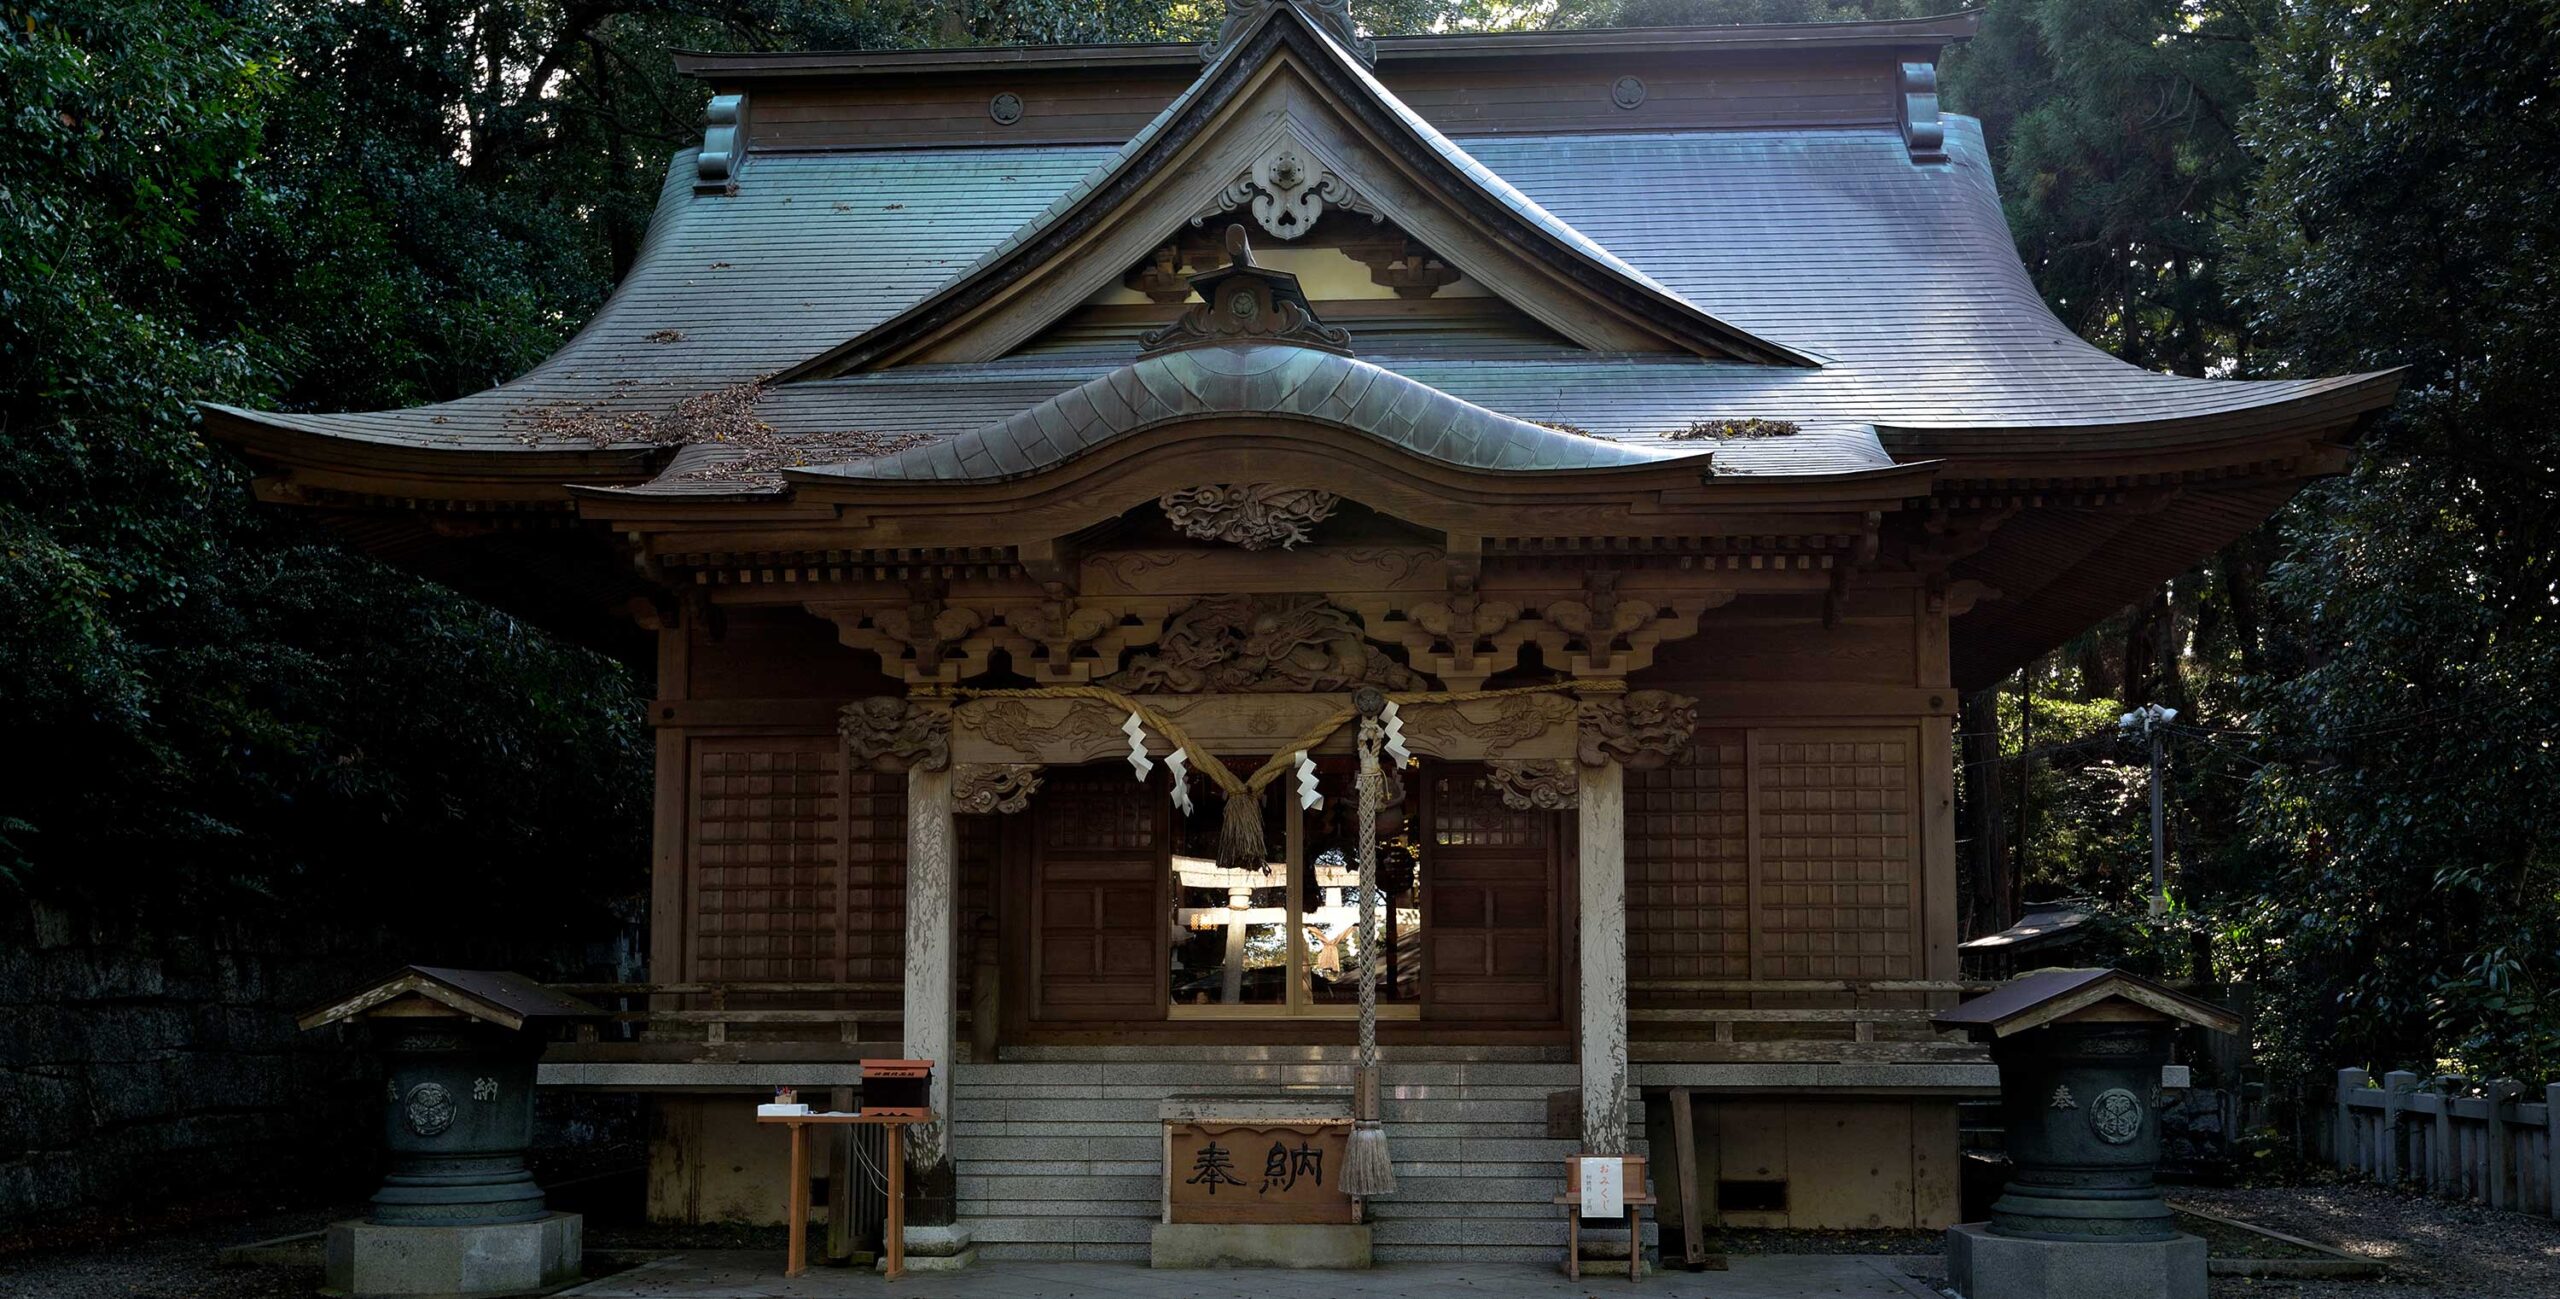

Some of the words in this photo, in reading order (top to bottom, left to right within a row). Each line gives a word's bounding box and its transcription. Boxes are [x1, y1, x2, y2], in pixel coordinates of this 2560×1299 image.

[472, 1076, 499, 1102] 納
[2049, 1084, 2080, 1112] 奉
[1186, 1141, 1324, 1196] 奉納
[1599, 1163, 1610, 1212] おみくじ
